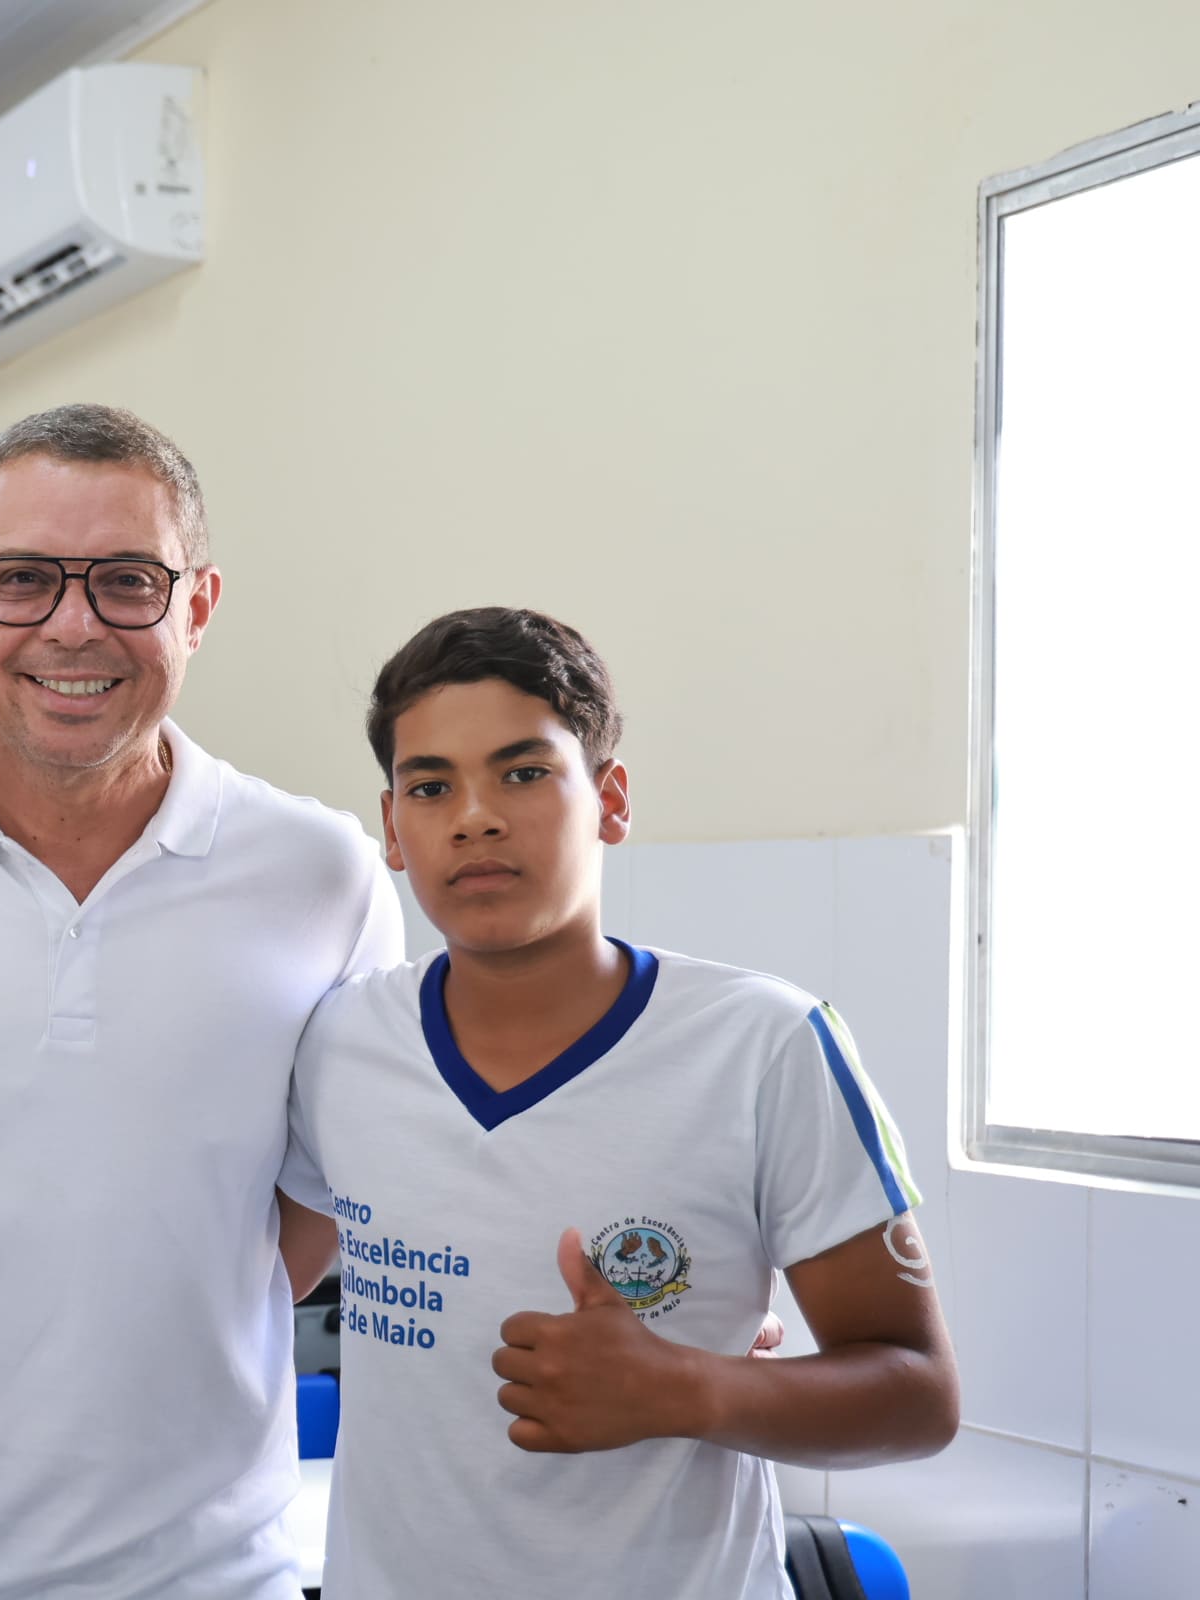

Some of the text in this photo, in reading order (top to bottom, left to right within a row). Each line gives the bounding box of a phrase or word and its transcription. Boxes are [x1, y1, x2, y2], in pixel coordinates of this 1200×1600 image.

[328, 1186, 372, 1225] entro
[591, 1221, 619, 1246] Centro
[624, 1217, 635, 1225] de
[346, 1229, 470, 1277] Excelência
[342, 1264, 443, 1312] uilombola
[650, 1311, 659, 1319] de
[662, 1298, 681, 1313] Maio
[349, 1304, 368, 1335] de
[372, 1311, 436, 1349] Maio
